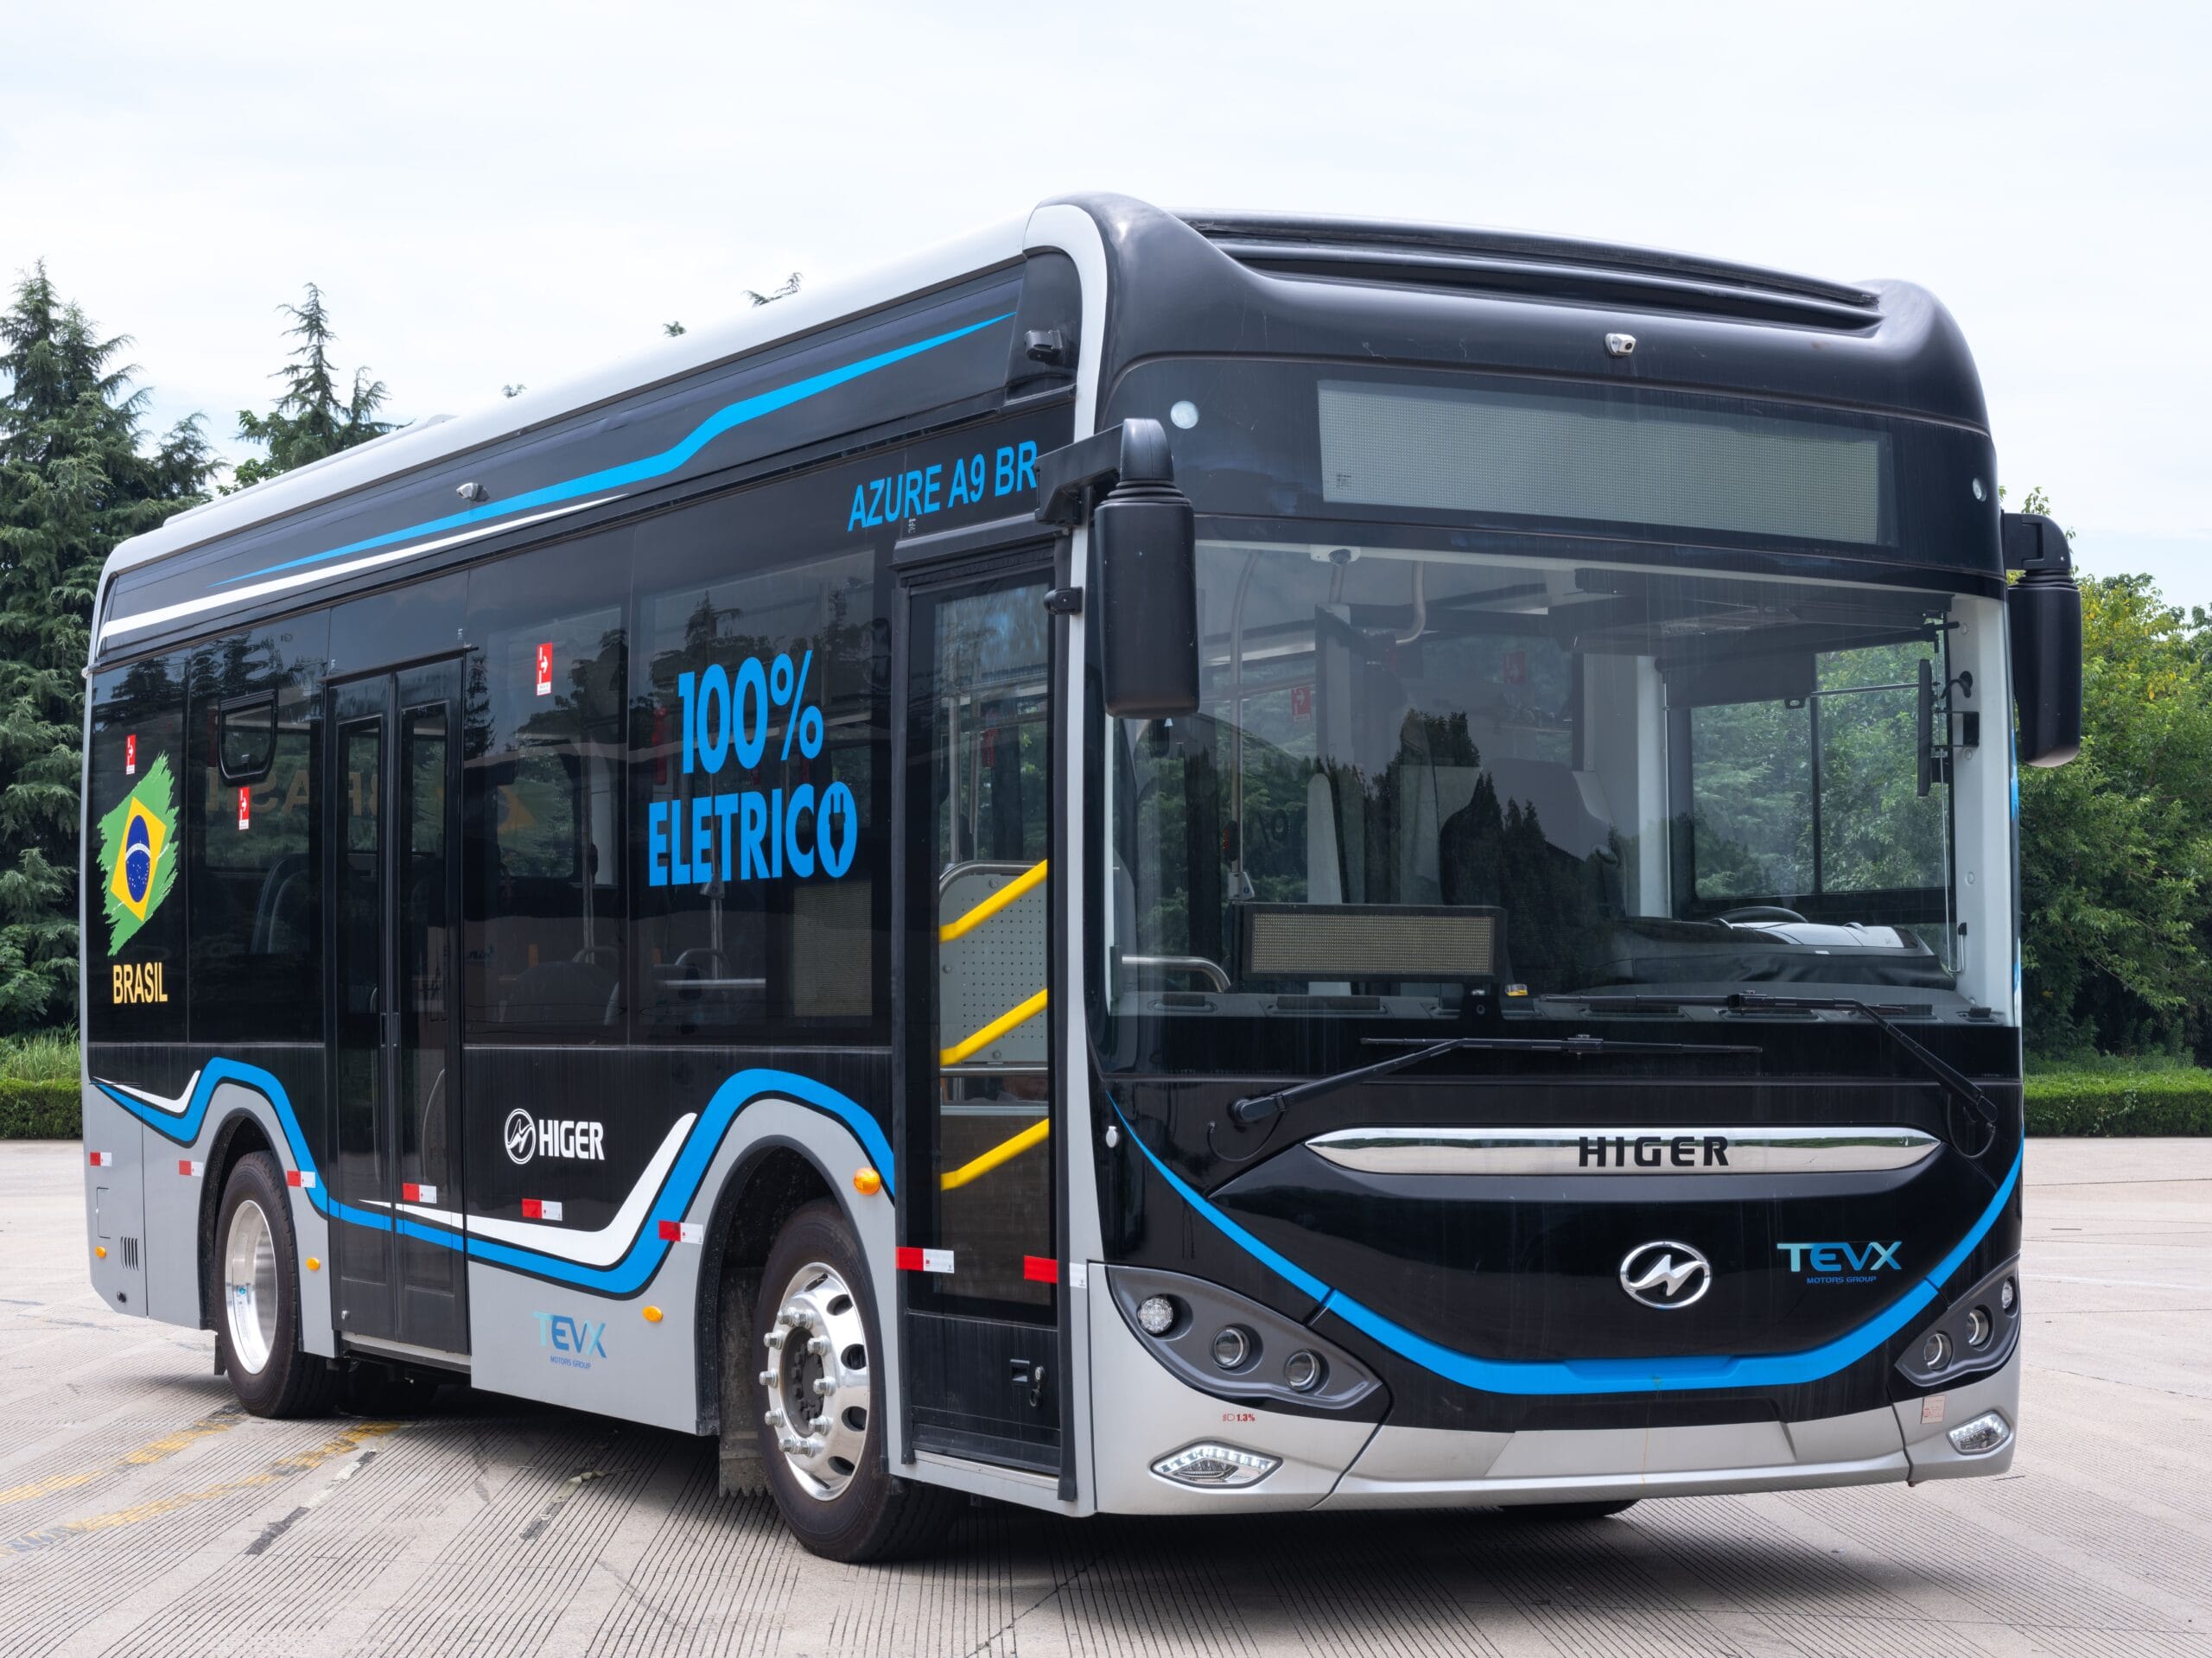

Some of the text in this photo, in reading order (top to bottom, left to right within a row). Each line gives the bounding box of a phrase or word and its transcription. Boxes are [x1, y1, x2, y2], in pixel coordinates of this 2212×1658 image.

[848, 441, 1038, 531] AZURE A9 BR
[677, 650, 824, 774] 100%
[649, 781, 857, 886] ELETRICO
[113, 962, 168, 1004] BRASIL
[538, 1119, 605, 1160] HIGER
[1579, 1136, 1729, 1167] HIGER
[1777, 1241, 1903, 1273] TEVX
[1807, 1275, 1877, 1285] MOTORS GROUP
[532, 1311, 607, 1358] TEVX
[550, 1355, 592, 1369] MOTORS GROUP
